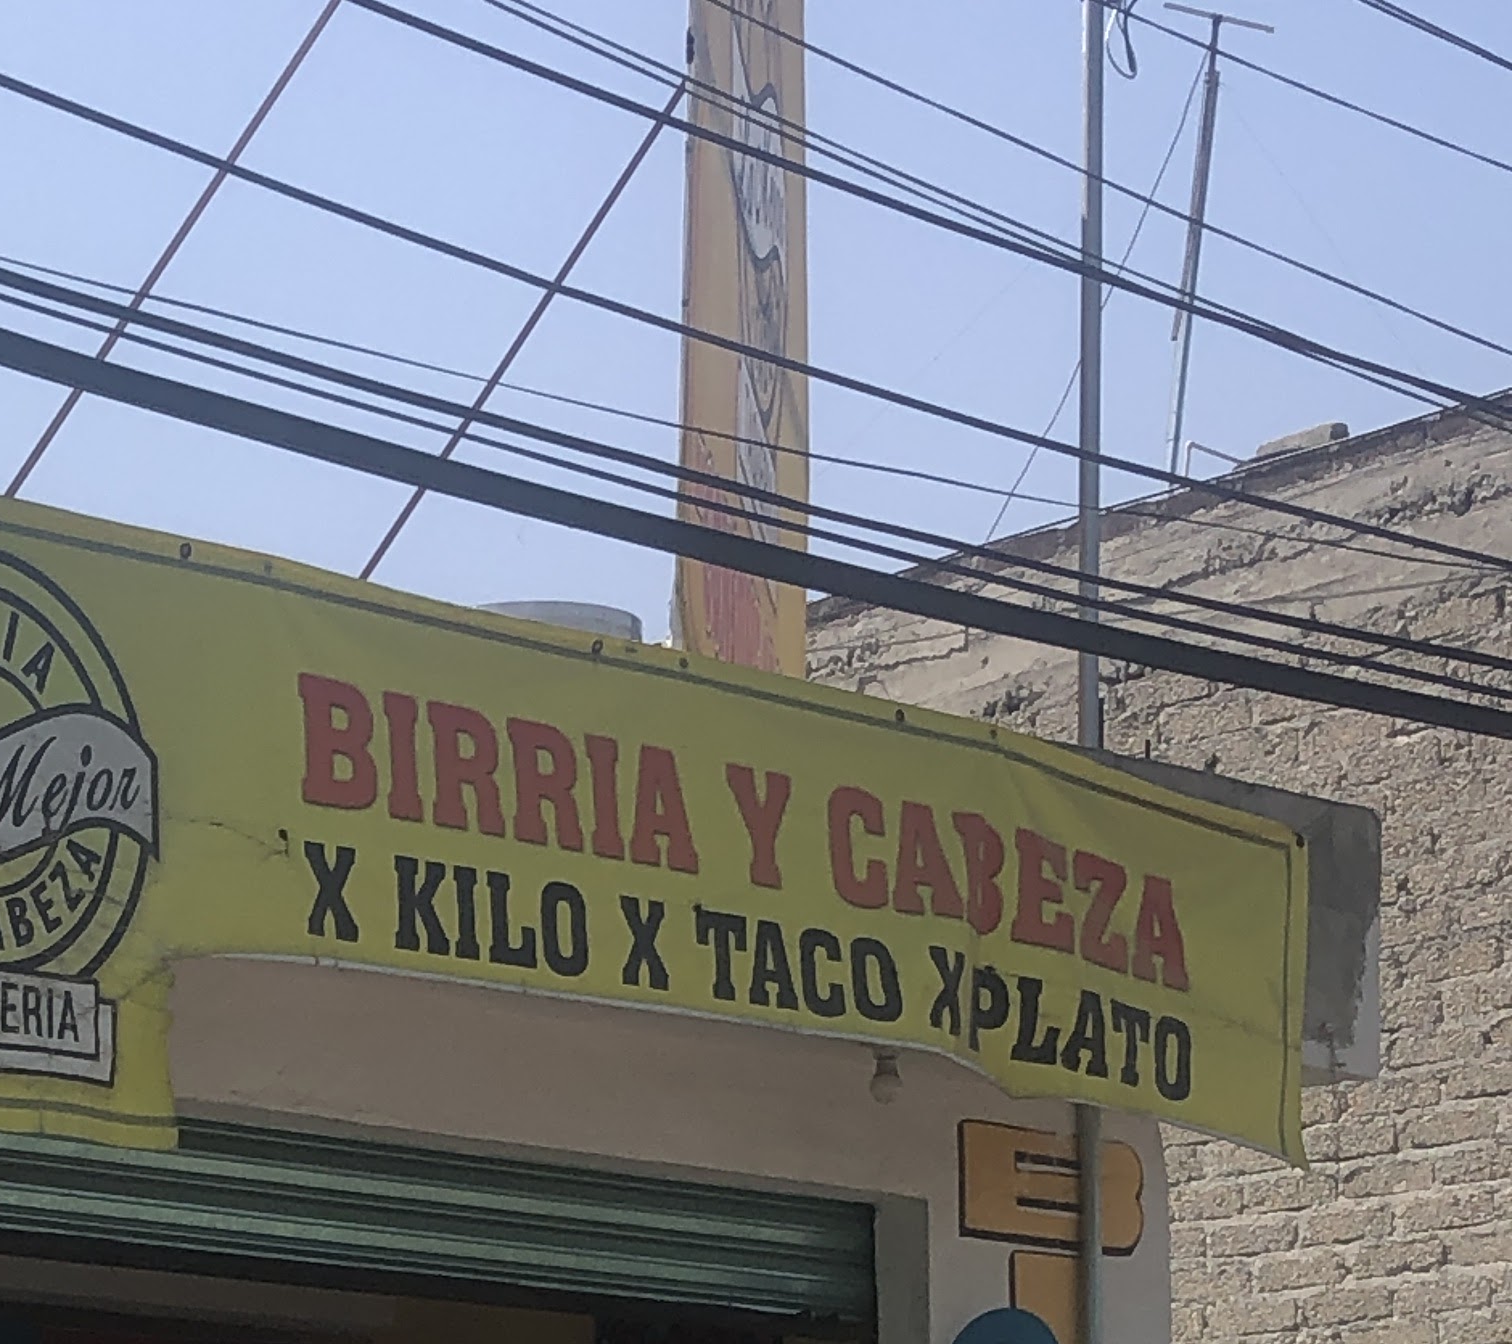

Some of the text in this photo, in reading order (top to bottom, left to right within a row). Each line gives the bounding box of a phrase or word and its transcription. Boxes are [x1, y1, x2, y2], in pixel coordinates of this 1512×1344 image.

[297, 672, 1190, 992] BIRRIA Y CABEZA
[304, 841, 359, 943] X
[394, 854, 589, 977] KILO
[620, 895, 671, 990] X
[693, 903, 905, 1022] TACO
